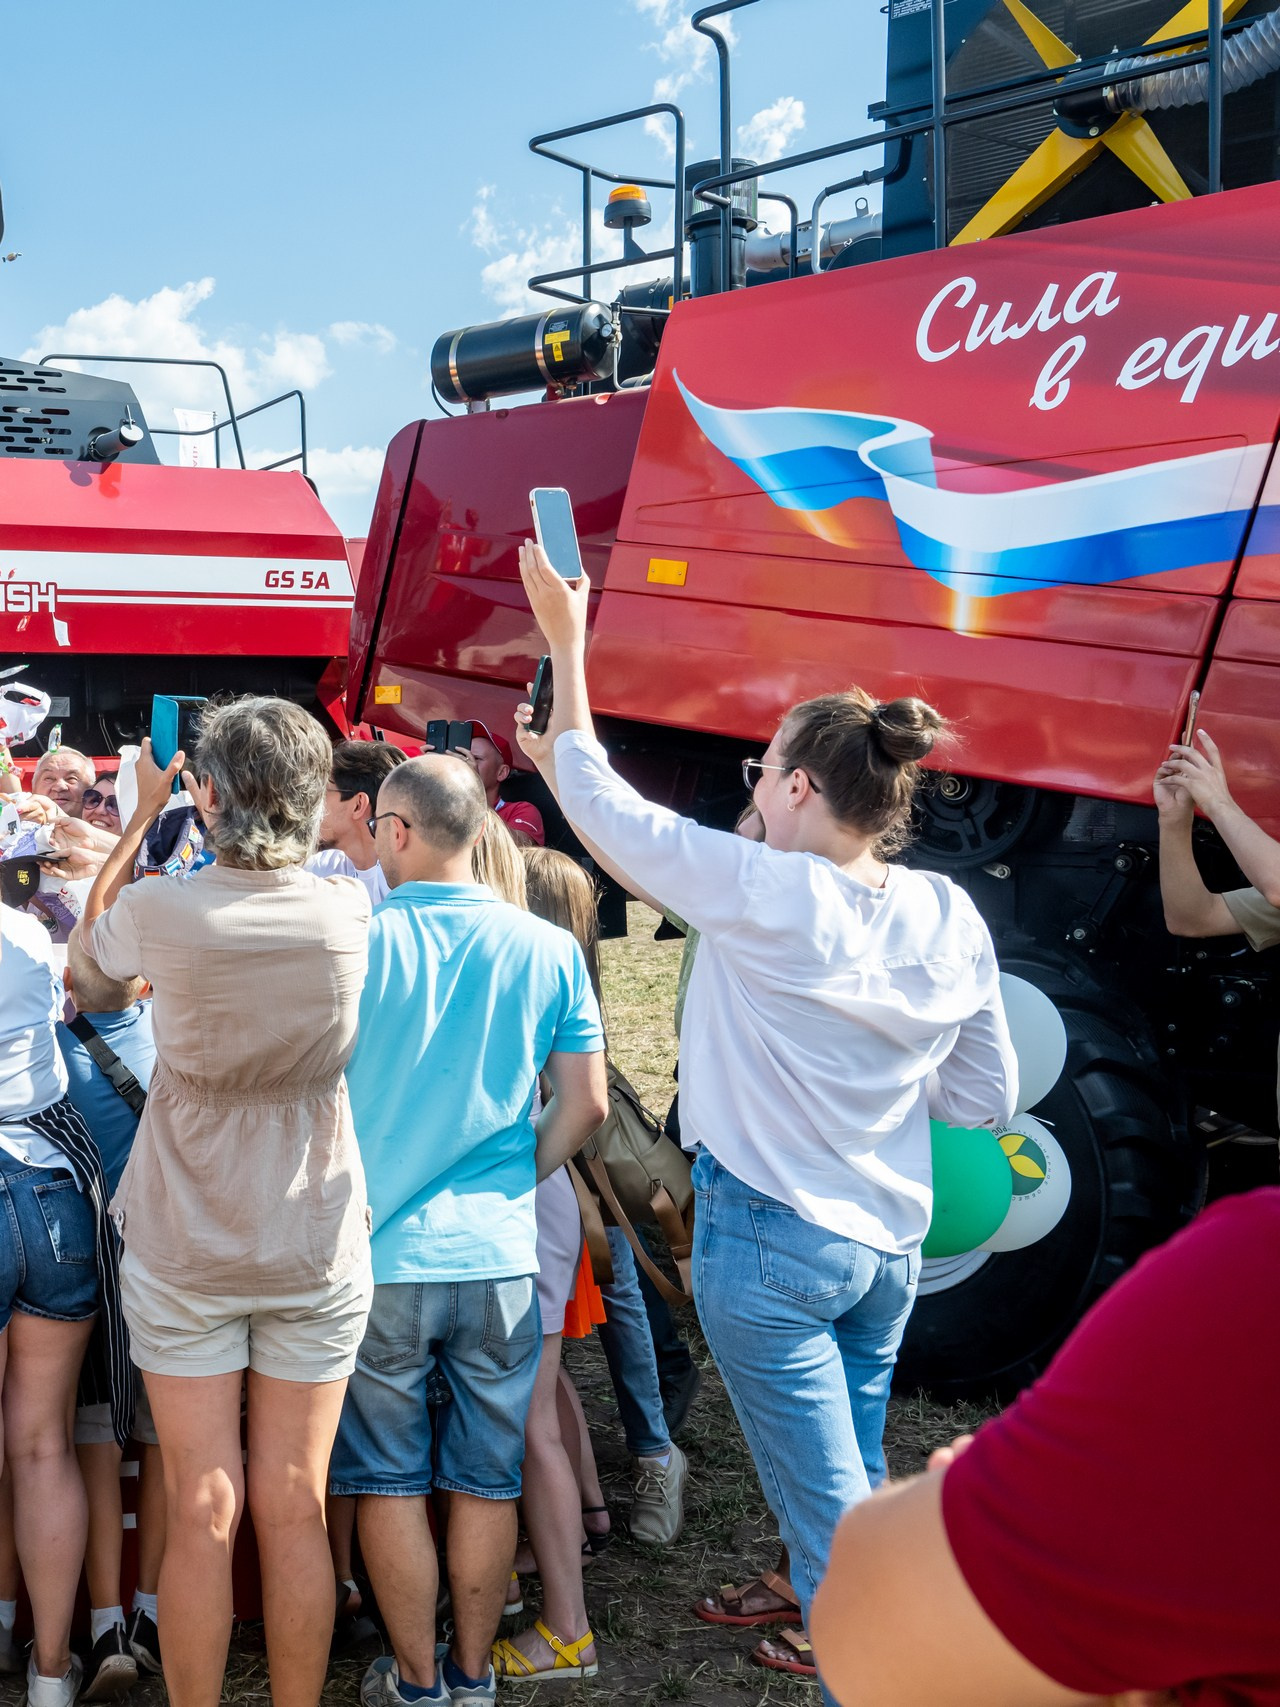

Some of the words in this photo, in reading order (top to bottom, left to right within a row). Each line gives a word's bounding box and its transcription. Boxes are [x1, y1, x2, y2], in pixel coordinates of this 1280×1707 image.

[915, 270, 1121, 363] Сила
[1028, 334, 1088, 411] в
[1115, 311, 1280, 404] еди
[264, 569, 295, 588] GS
[300, 570, 330, 590] 5A
